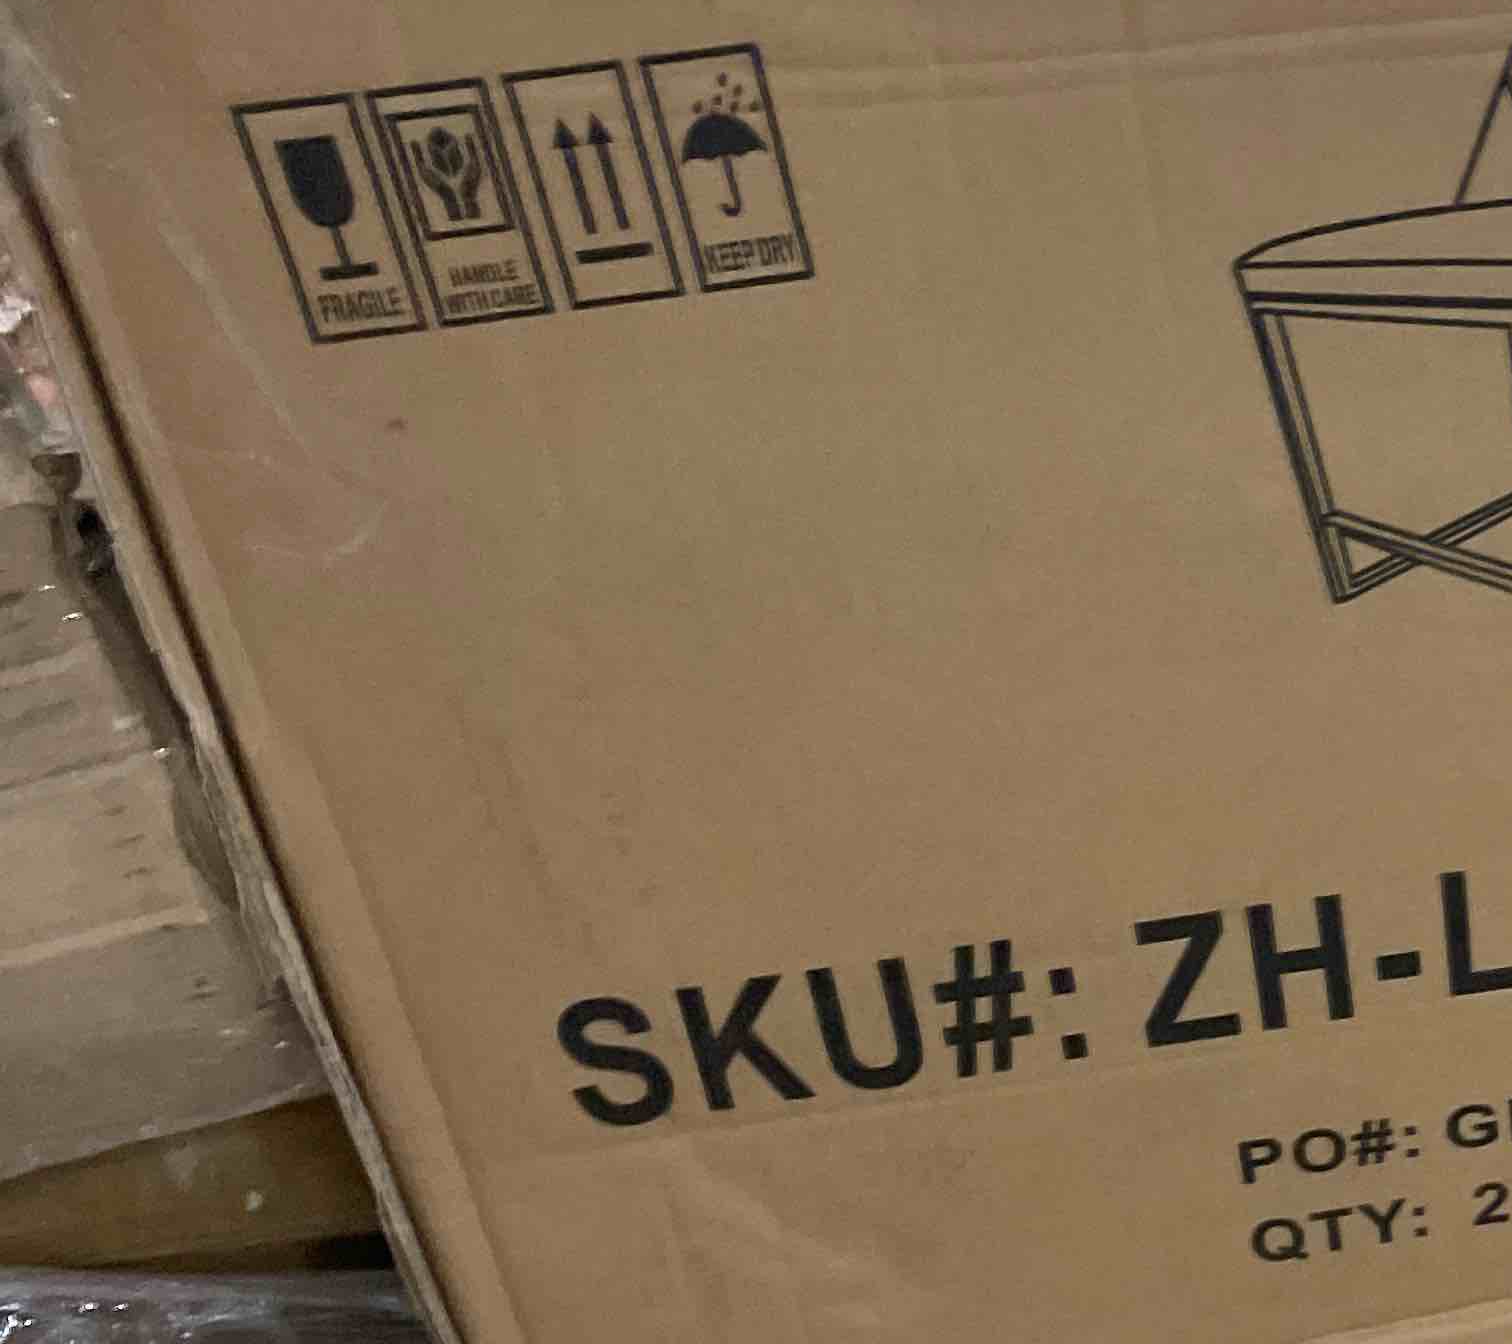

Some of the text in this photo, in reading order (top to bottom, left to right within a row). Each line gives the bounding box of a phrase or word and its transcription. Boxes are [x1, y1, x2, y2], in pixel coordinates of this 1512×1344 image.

[448, 258, 521, 288] HANDLE
[703, 233, 797, 273] KEEP DRY
[317, 287, 405, 324] FRAGILE
[446, 283, 542, 316] WITH CARE
[556, 938, 1090, 1128] SKU#:
[1236, 1119, 1422, 1185] PO#:
[1251, 1199, 1430, 1262] QTY:
[1472, 1181, 1510, 1226] 2
